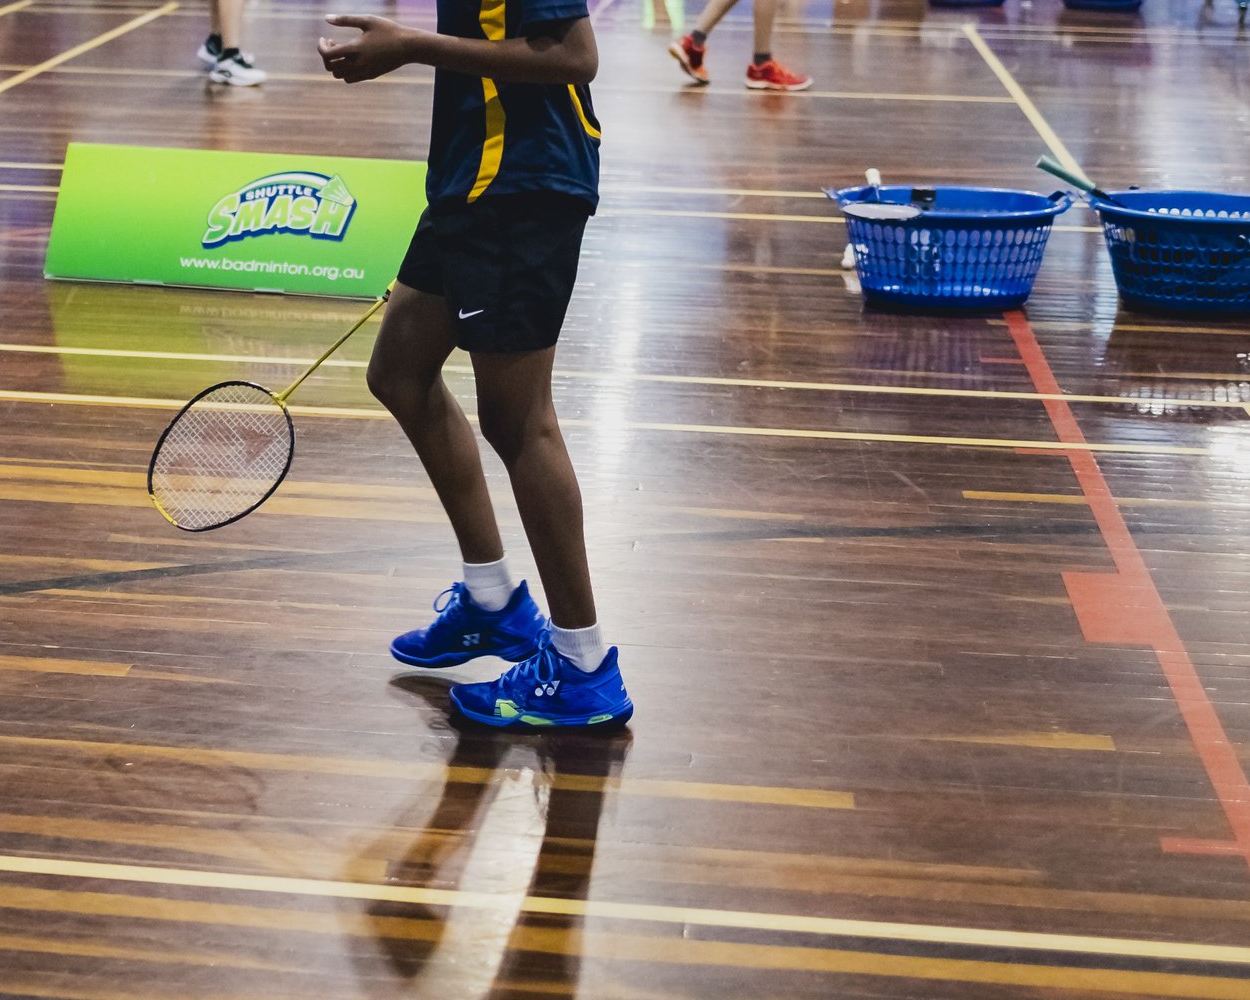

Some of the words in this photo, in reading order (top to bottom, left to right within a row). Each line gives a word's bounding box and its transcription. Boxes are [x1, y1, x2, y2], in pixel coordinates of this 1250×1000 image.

[245, 184, 312, 200] SHUTTLE
[202, 192, 354, 244] SMASH
[180, 257, 365, 280] www.badminton.org.au
